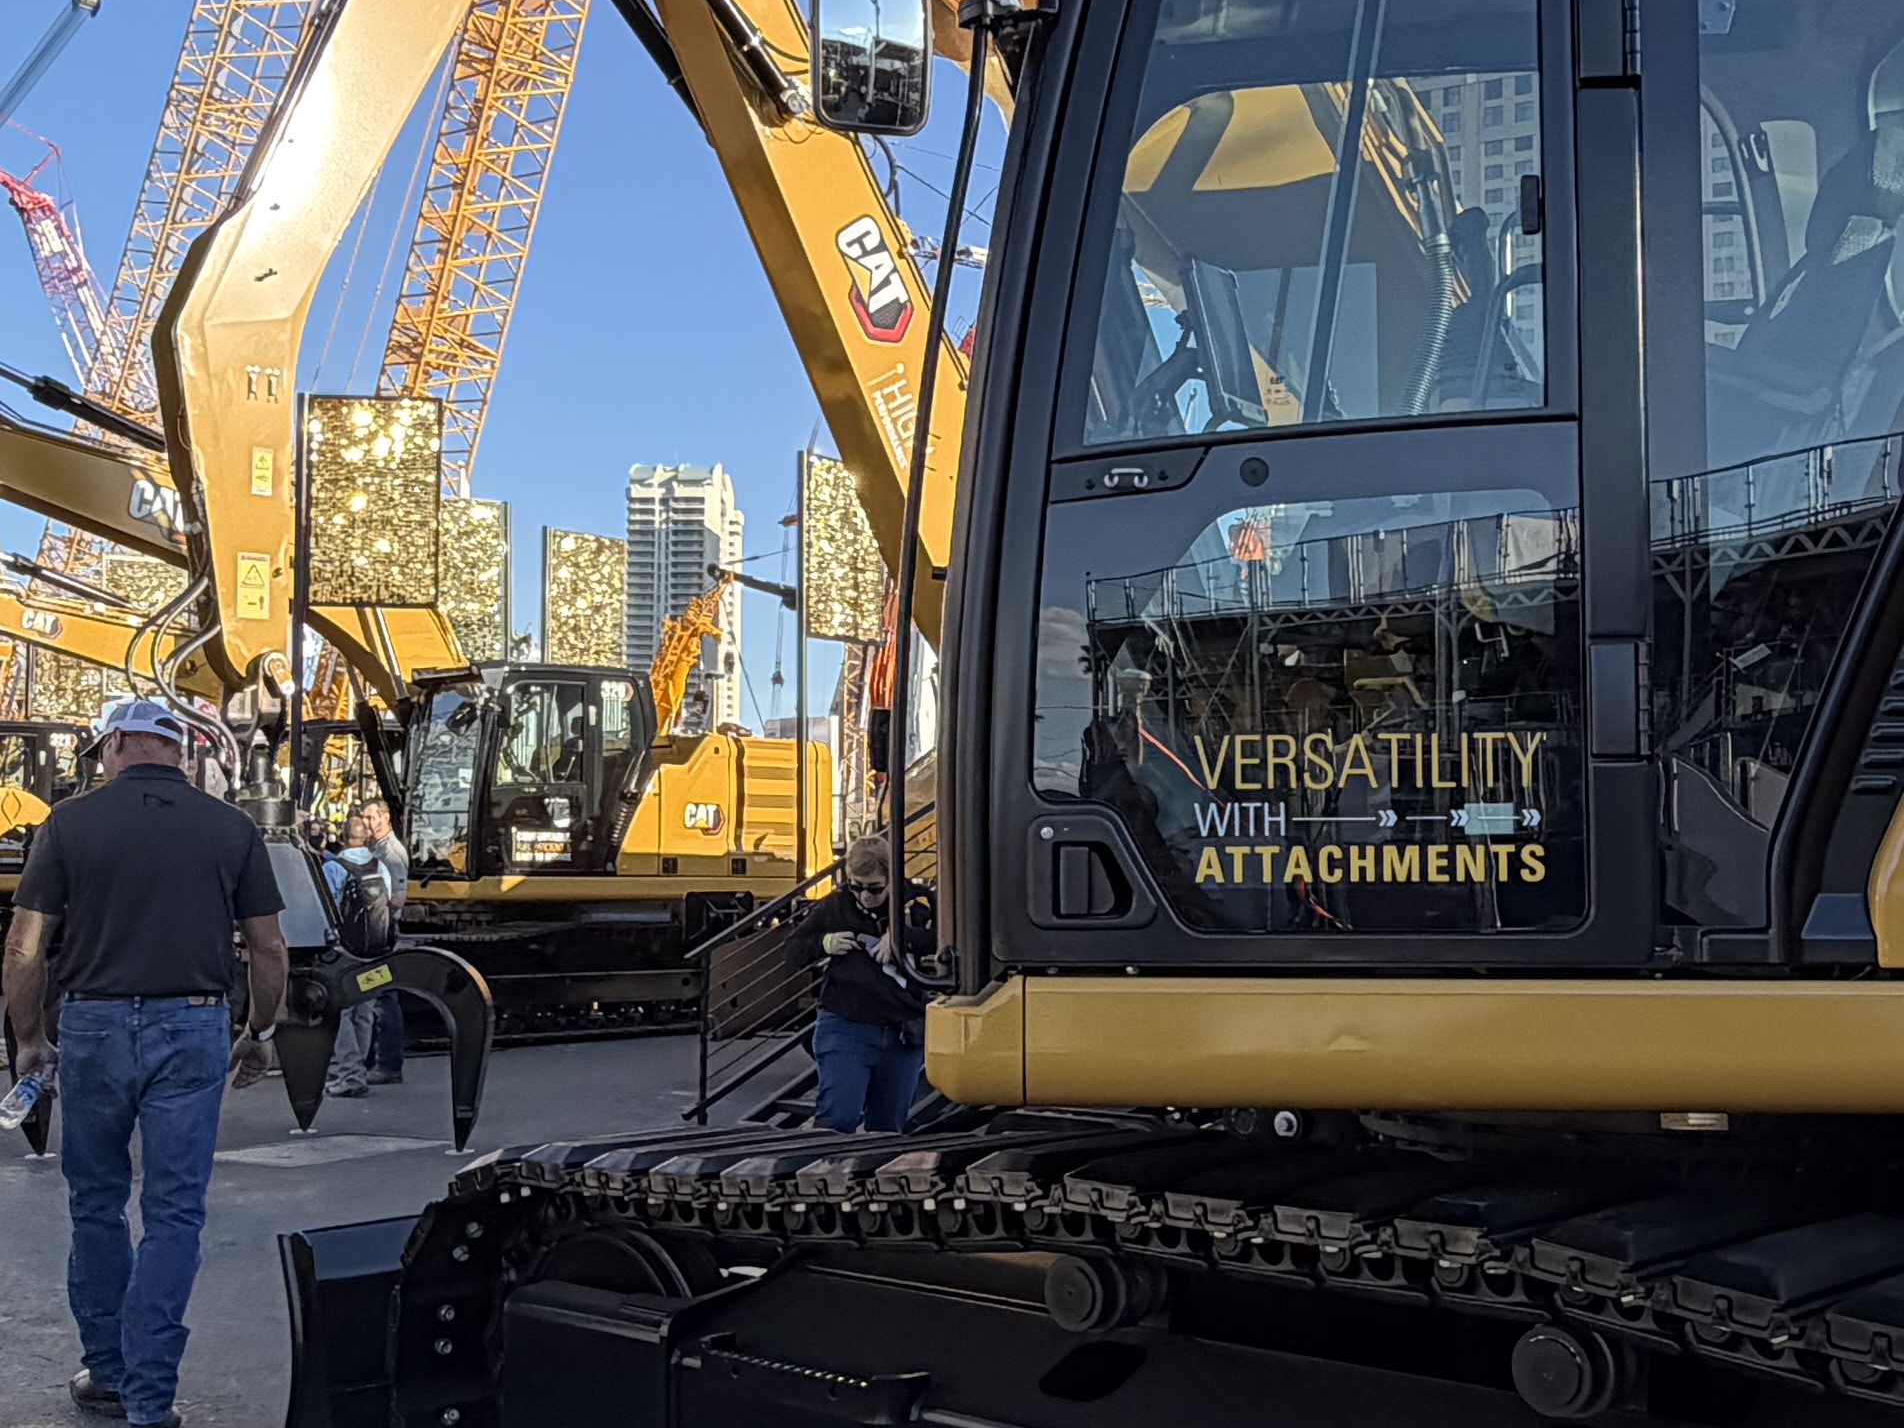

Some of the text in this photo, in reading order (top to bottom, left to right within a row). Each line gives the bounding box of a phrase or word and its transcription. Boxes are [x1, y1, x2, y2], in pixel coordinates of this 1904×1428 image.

[836, 215, 910, 314] CAT
[881, 377, 935, 455] HIG
[21, 607, 57, 634] CAT
[1193, 731, 1544, 790] VERSATILITY
[684, 802, 718, 829] CAT
[1193, 801, 1286, 837] WITH
[1194, 843, 1547, 884] ATTACHMENTS
